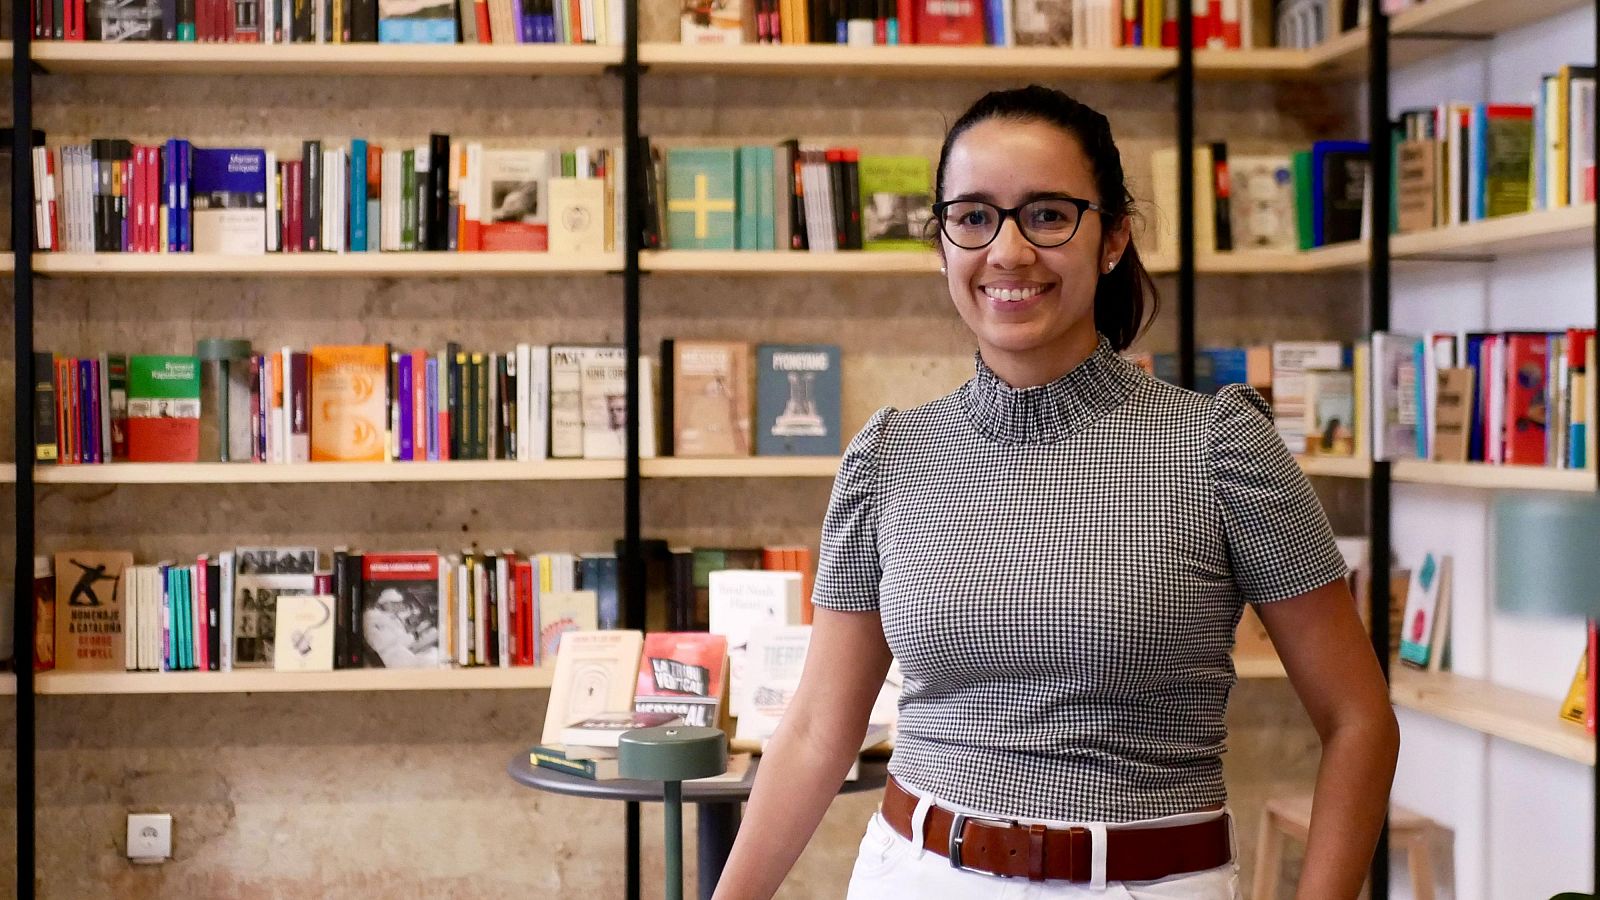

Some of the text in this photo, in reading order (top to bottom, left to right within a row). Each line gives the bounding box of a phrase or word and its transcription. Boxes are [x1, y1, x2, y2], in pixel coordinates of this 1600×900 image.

[230, 153, 259, 163] Mariana
[772, 351, 829, 371] PYONGYANG
[71, 609, 120, 621] HOMENAJE
[76, 620, 122, 633] CATALUÑA
[79, 635, 113, 646] GEORGE
[77, 648, 113, 659] ORWELL
